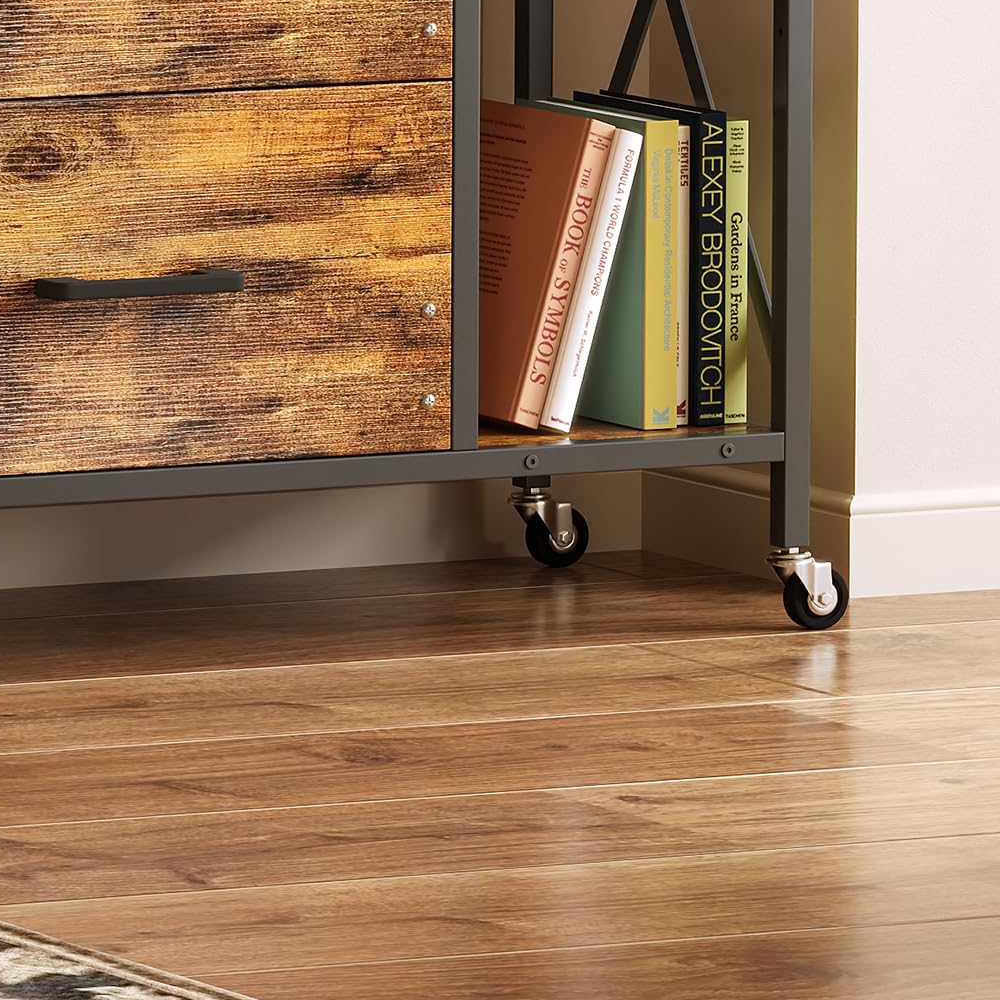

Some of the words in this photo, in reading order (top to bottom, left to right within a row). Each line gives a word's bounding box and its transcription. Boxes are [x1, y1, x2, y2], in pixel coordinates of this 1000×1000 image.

[579, 168, 592, 189] THE
[615, 149, 636, 195] FORMULA
[680, 139, 689, 187] TEXTILES
[701, 121, 724, 224] ALEXEY
[563, 194, 593, 256] BOOK
[606, 204, 621, 239] WORLD
[662, 186, 672, 246] Contemporary
[730, 212, 743, 272] Gardens
[590, 241, 612, 297] CHAMPIONS
[663, 250, 672, 296] Residential
[730, 273, 742, 288] in
[530, 278, 571, 386] SYMBOLS
[663, 299, 672, 352] Architecture
[700, 232, 724, 406] BRODOVITCH
[730, 292, 743, 342] France
